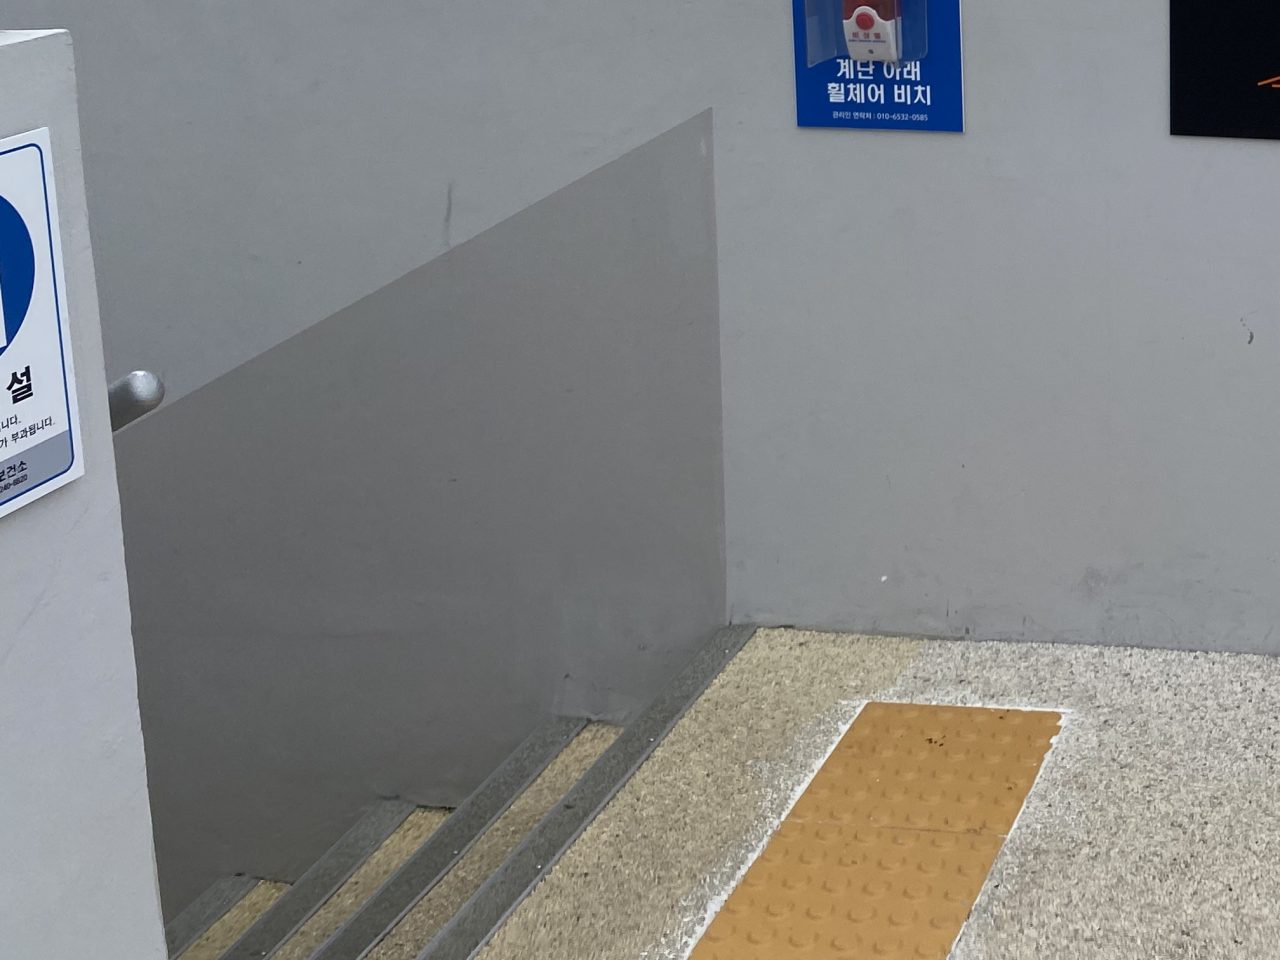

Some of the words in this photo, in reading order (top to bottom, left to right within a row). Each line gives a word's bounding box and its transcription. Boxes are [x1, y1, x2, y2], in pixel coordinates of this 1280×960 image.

[836, 58, 876, 81] 계단
[883, 60, 921, 81] 아래
[827, 82, 886, 105] 휠체어
[894, 84, 931, 106] 비치
[6, 365, 34, 405] 설
[0, 414, 22, 432] 니다.
